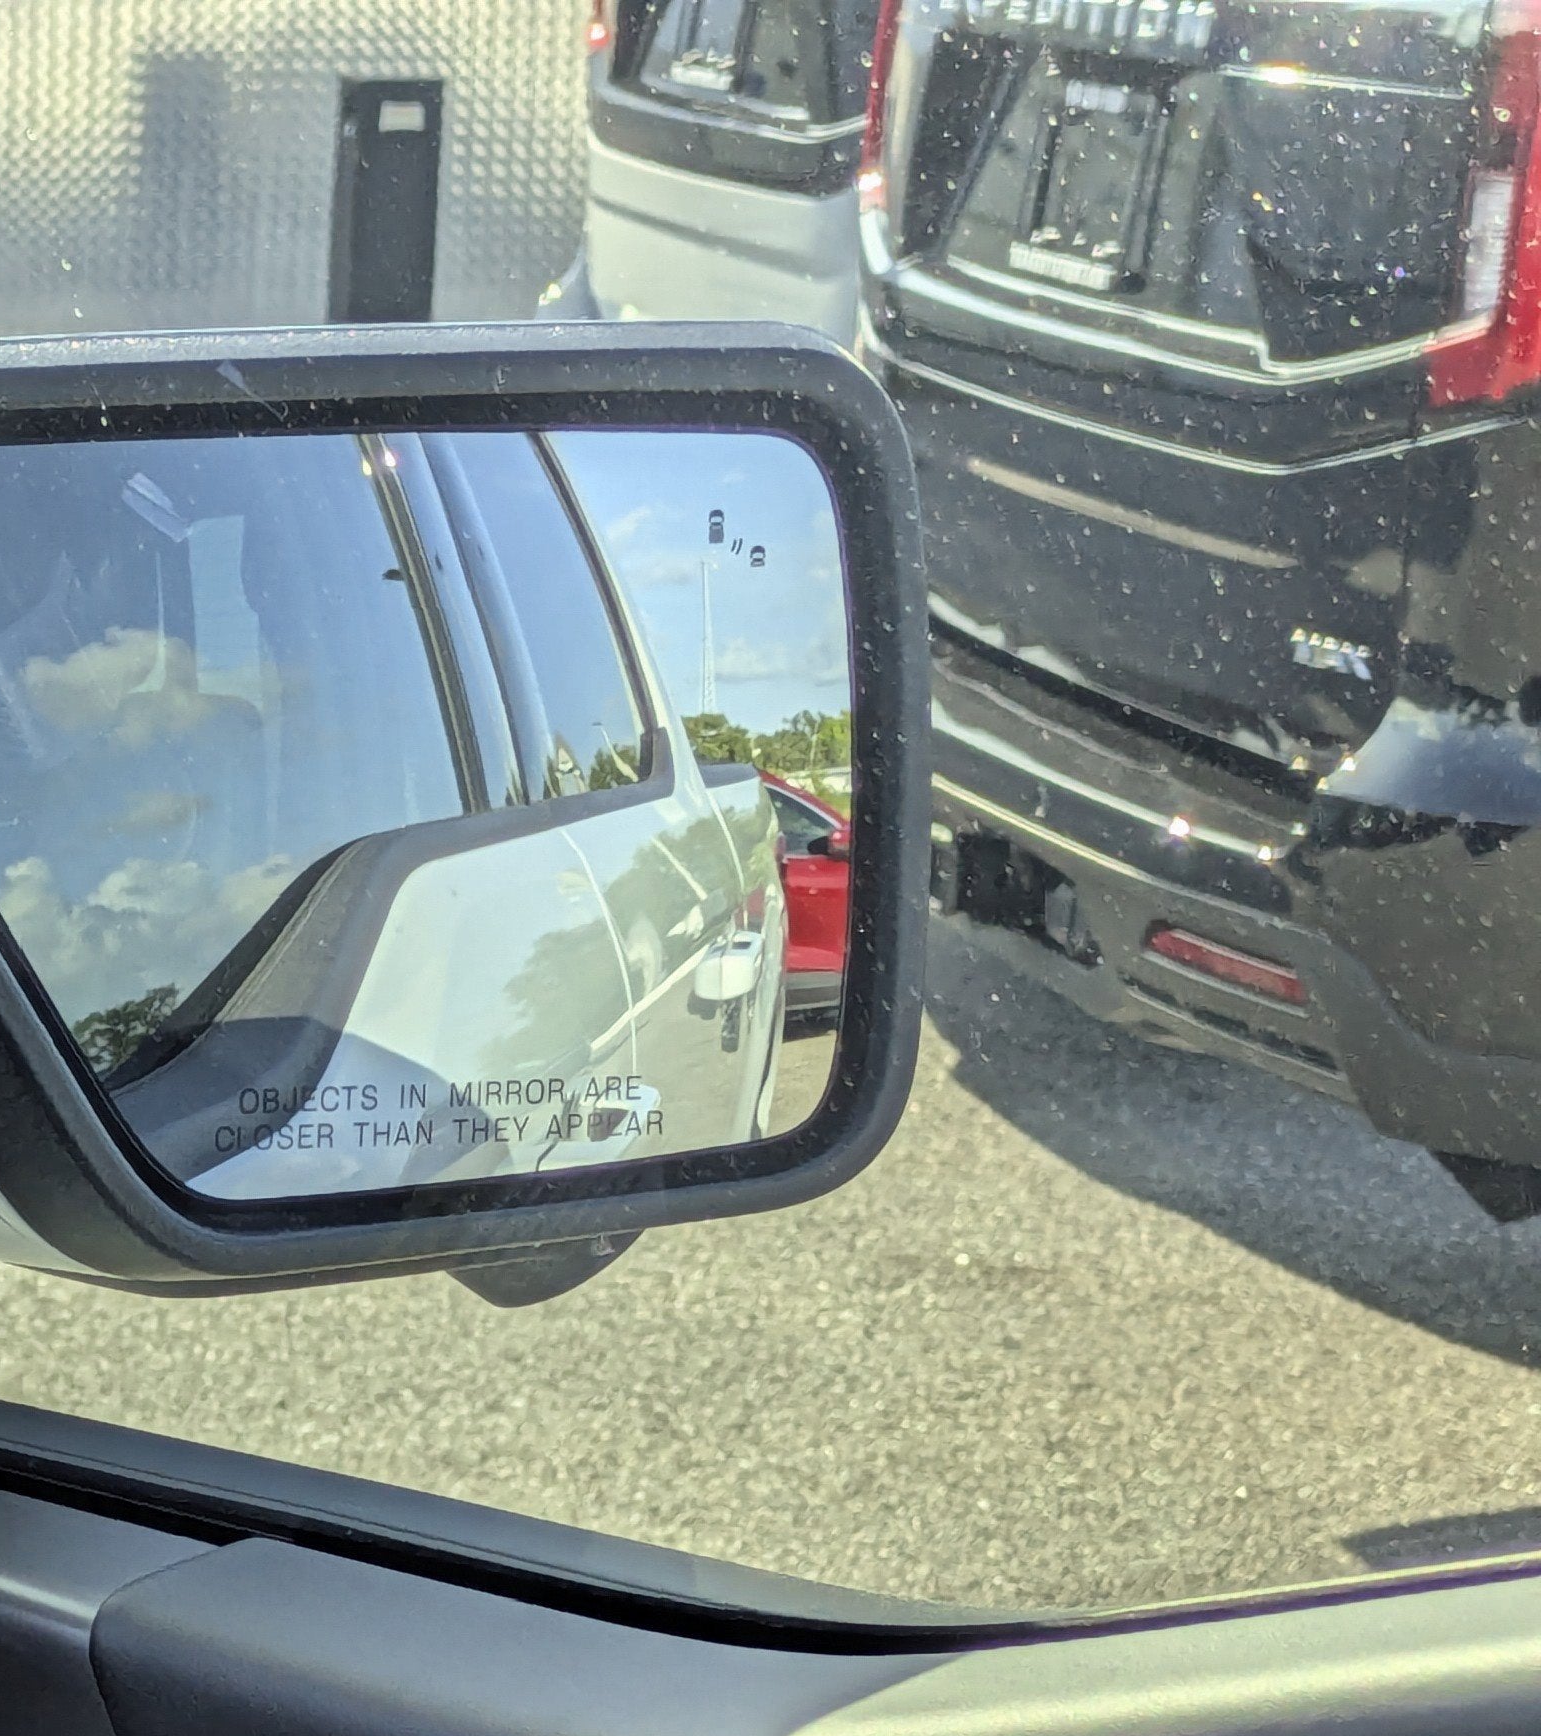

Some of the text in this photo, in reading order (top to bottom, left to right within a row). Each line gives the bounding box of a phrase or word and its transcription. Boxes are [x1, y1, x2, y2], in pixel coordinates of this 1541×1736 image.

[238, 1075, 644, 1116] OBJECTS IN MIRROR ARE
[215, 1109, 664, 1154] CLOSER THAN THEY APPEAR
